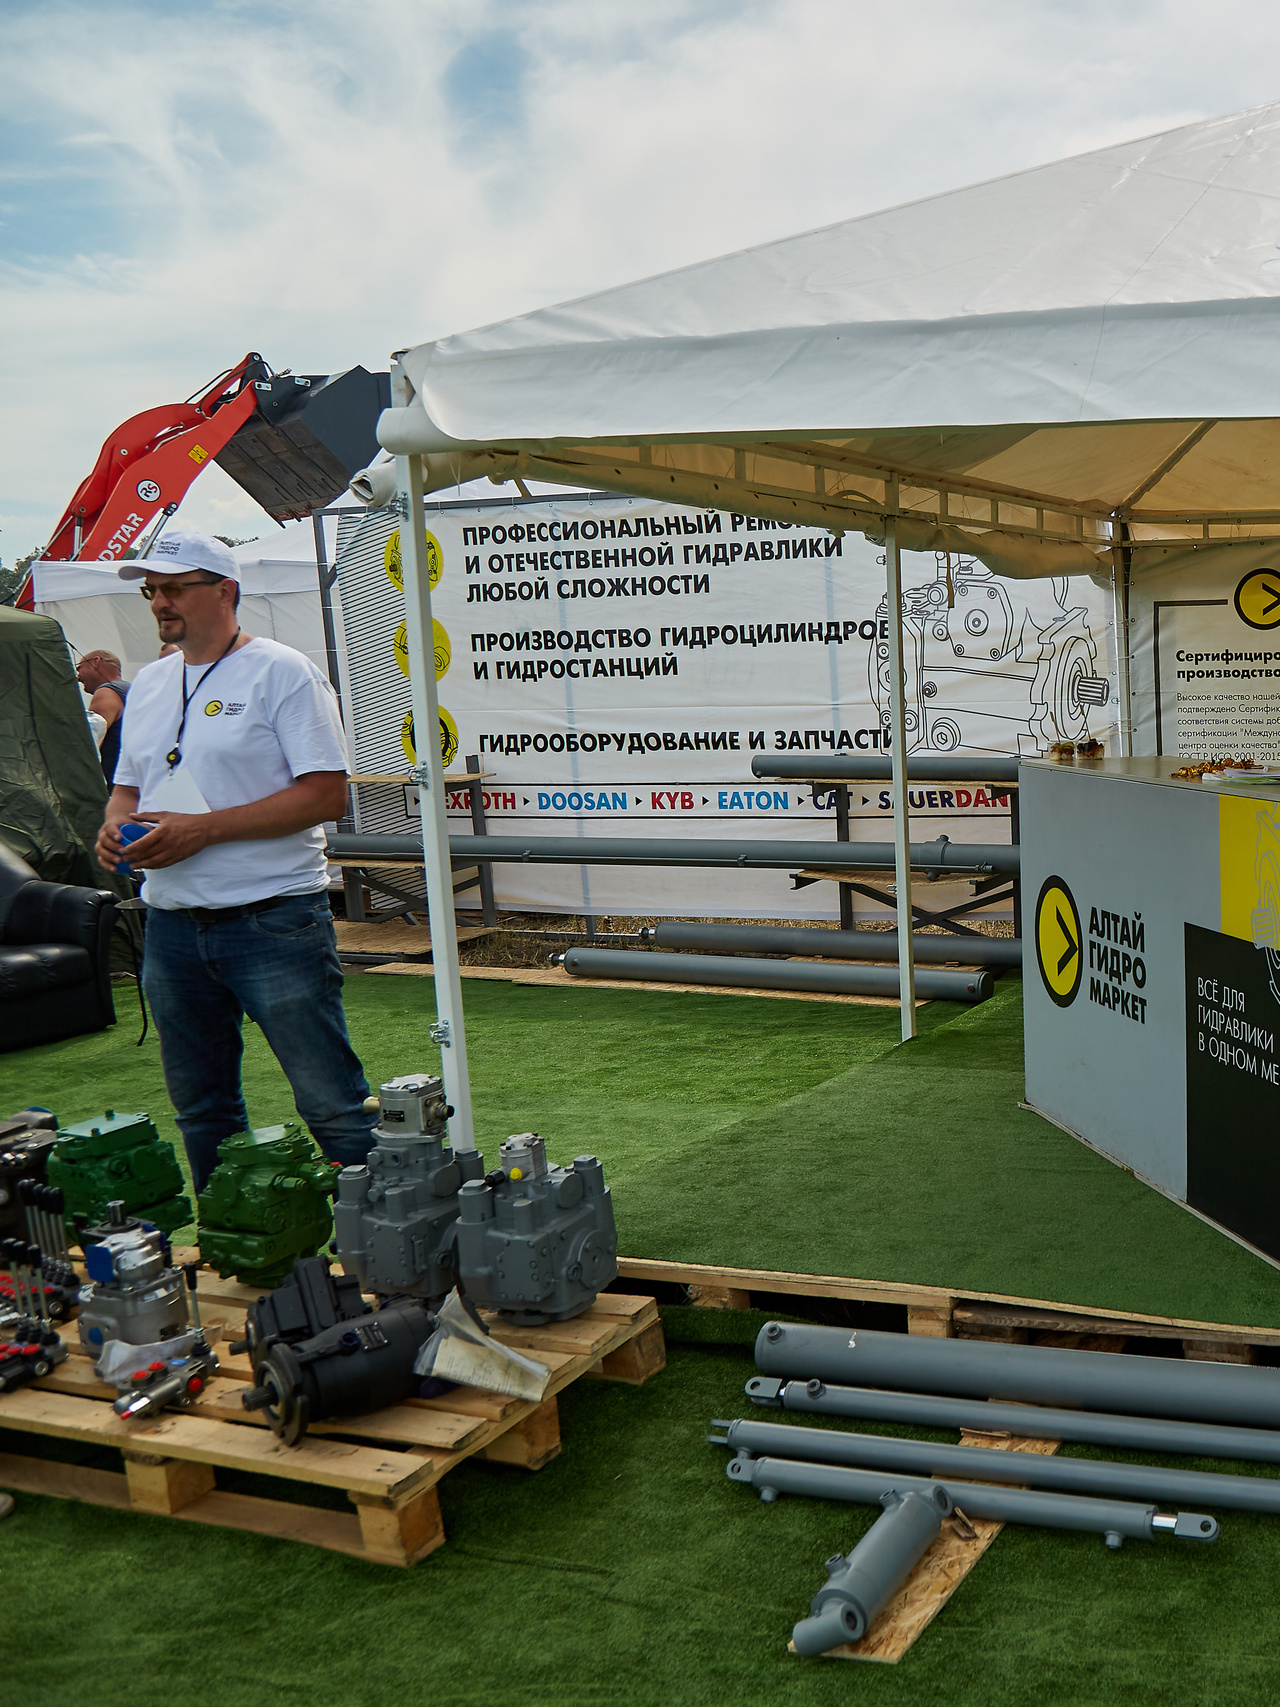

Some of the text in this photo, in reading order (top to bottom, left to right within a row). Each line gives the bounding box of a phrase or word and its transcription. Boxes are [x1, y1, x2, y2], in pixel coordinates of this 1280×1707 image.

[97, 512, 144, 561] DSTAR
[463, 508, 722, 546] ПРОФЕССИОНАЛЬНЫЙ
[465, 537, 843, 574] И ОТЕЧЕСТВЕННОЙ ГИДРАВЛИКИ
[467, 574, 710, 603] ЛЮБОЙ СЛОЖНОСТИ
[471, 627, 651, 653] ПРОИЗВОДСТВО
[473, 651, 679, 682] И ГИДРОСТАНЦИЙ
[1177, 692, 1212, 701] Высокое
[1214, 693, 1250, 701] качество
[1252, 692, 1280, 701] нашей
[1177, 706, 1236, 714] подтверждено
[479, 731, 741, 756] ГИДРООБОРУДОВАНИЕ
[749, 731, 765, 749] И
[1178, 729, 1238, 739] сертификации
[1178, 742, 1207, 750] центра
[1209, 742, 1239, 750] оценки
[1211, 753, 1232, 761] ИСО
[445, 792, 516, 810] XROTH
[538, 792, 627, 810] DOOSAN
[651, 791, 695, 810] KYB
[718, 791, 789, 810] EATON
[1089, 906, 1145, 953] АЛТАЙ
[1089, 939, 1147, 989] ГИДРО
[1089, 976, 1147, 1025] МАРКЕТ
[1198, 976, 1245, 1013] ВСЁ ДЛЯ
[1198, 1004, 1274, 1054] ГИДРАВЛИКИ
[1198, 1031, 1205, 1051] В
[1208, 1036, 1257, 1076] ОДНОМ
